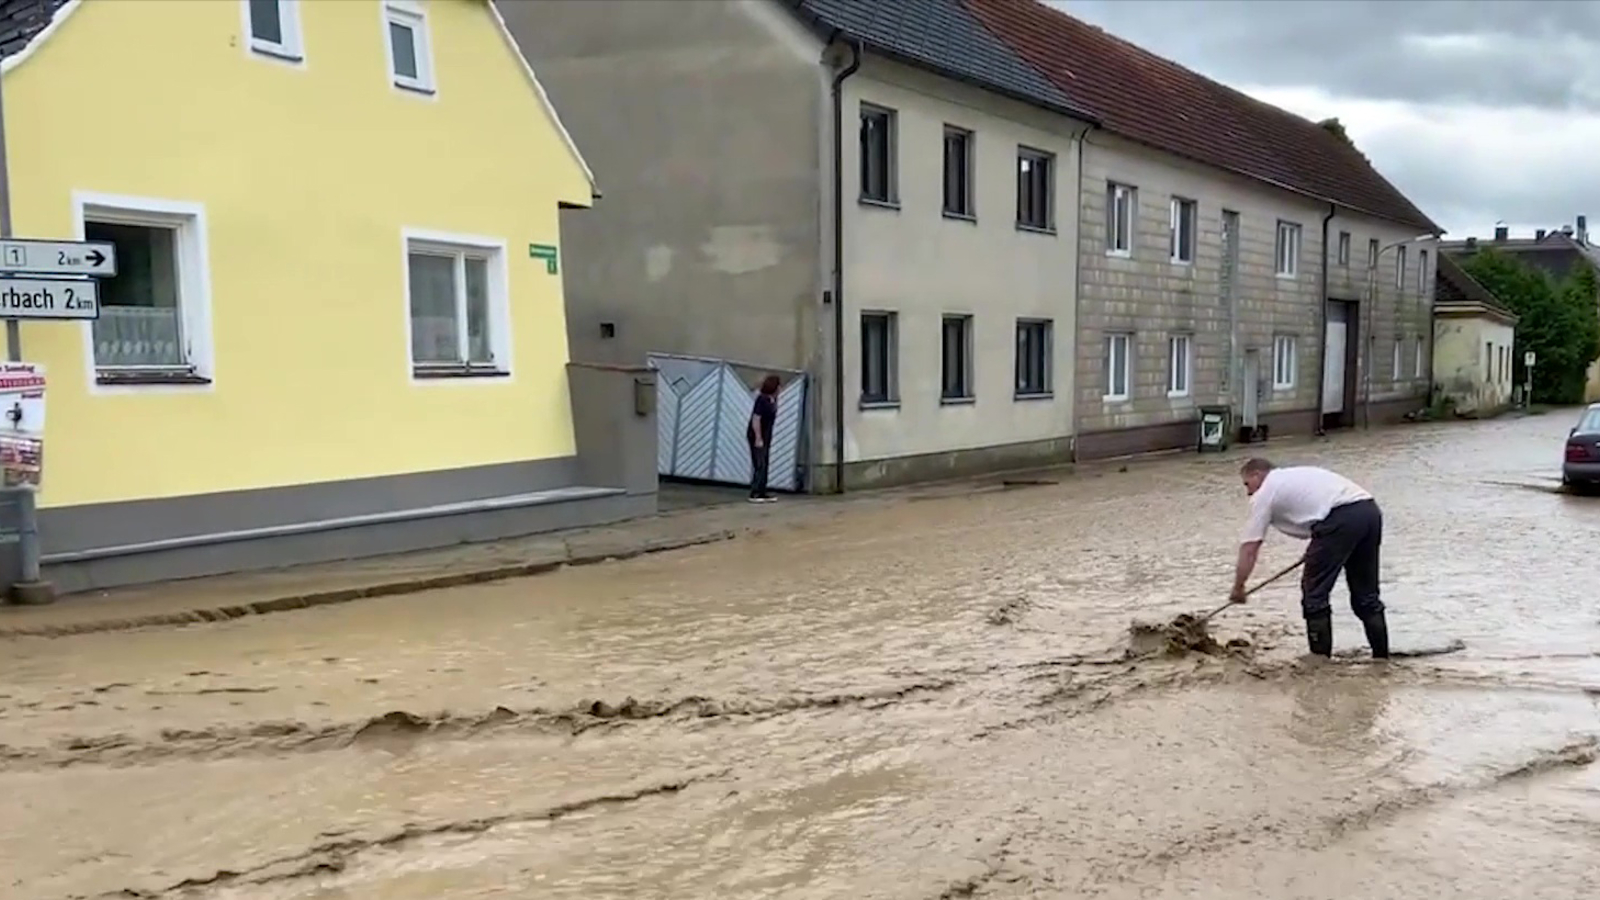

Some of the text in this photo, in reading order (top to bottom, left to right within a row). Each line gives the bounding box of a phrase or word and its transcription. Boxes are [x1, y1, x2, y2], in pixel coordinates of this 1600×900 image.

[11, 249, 80, 265] 1 2 km
[0, 286, 93, 309] rbach 2 km
